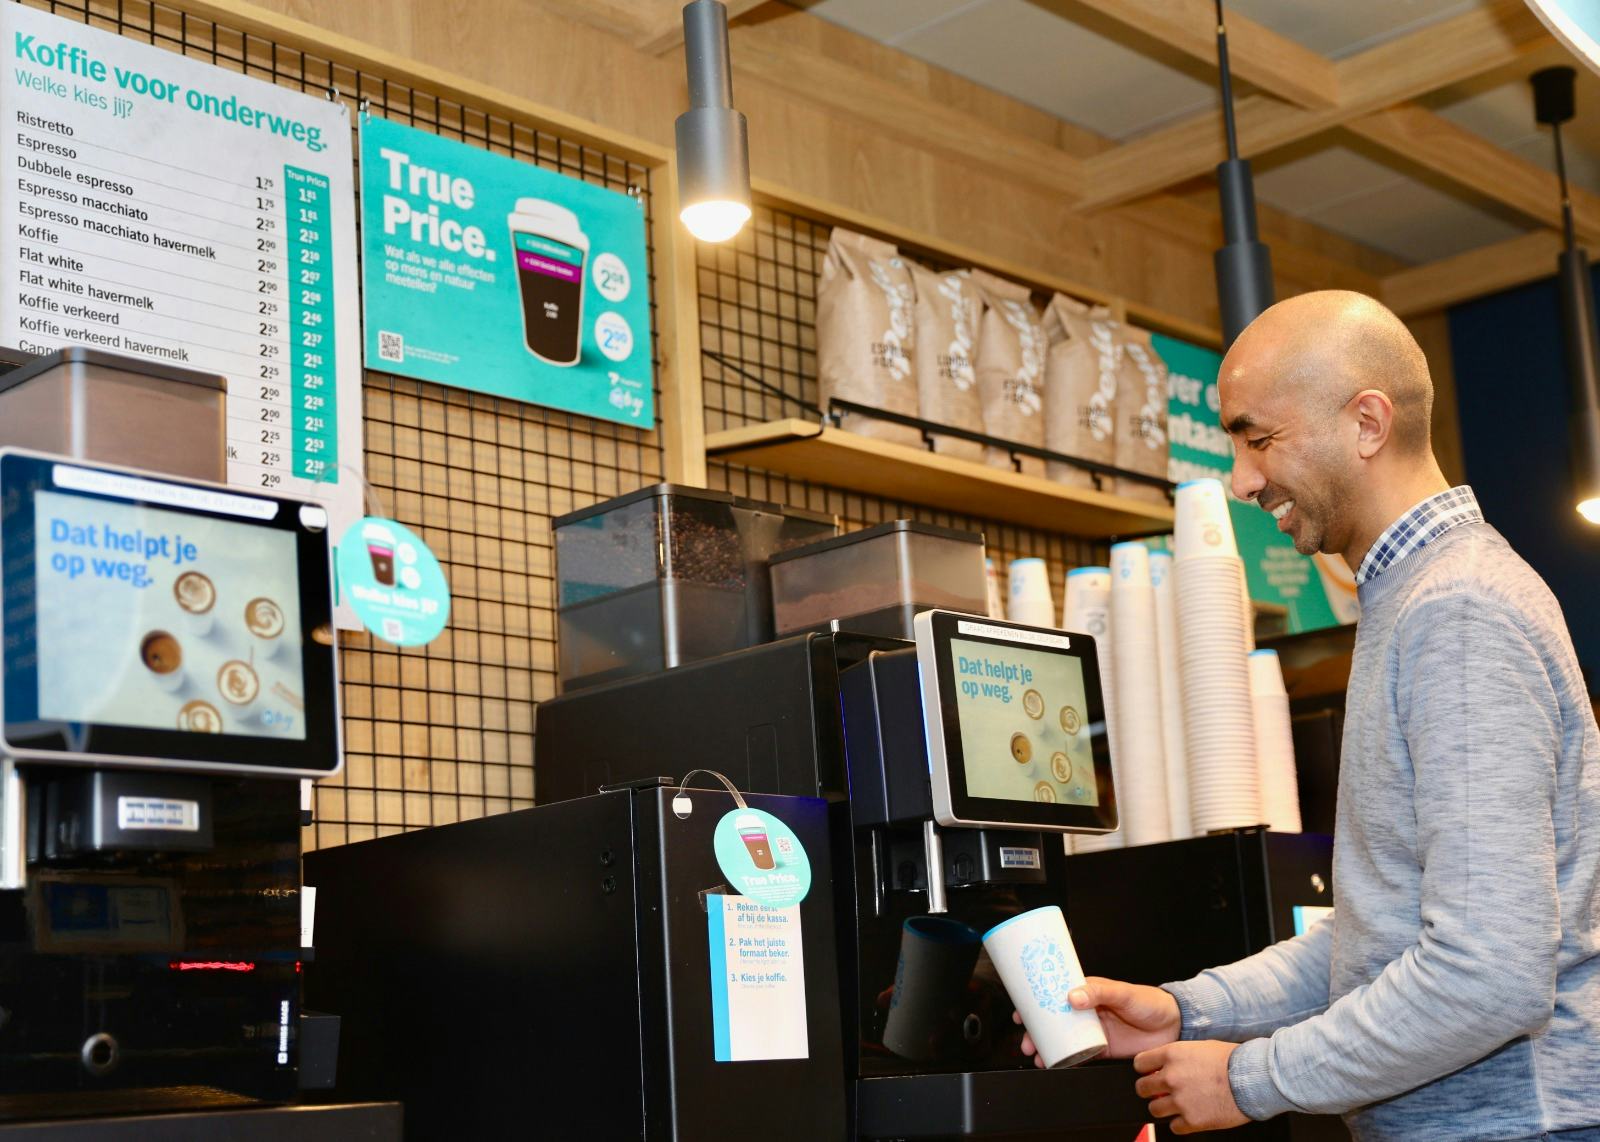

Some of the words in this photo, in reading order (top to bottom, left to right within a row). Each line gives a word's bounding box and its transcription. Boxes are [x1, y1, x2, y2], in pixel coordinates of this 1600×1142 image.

[14, 31, 107, 83] Koffie
[113, 67, 181, 104] voor
[186, 89, 328, 152] onderweg.
[15, 69, 68, 98] Welke
[73, 84, 108, 110] kies
[112, 96, 134, 119] jij?
[17, 111, 74, 137] Ristretto
[17, 133, 77, 160] Espresso
[18, 156, 72, 180] Dubbele
[76, 173, 134, 196] espresso
[286, 169, 305, 182] True
[307, 175, 327, 189] Price
[380, 147, 475, 210] True
[18, 179, 78, 205] Espresso
[82, 195, 148, 221] macchiato
[18, 201, 79, 228] Espresso
[83, 217, 150, 244] macchiato
[153, 234, 216, 260] havermelk
[18, 224, 59, 244] Koffie
[384, 195, 496, 262] Price.
[19, 247, 44, 263] Flat
[48, 253, 84, 272] white
[384, 244, 404, 260] Wat
[406, 251, 420, 264] als
[422, 256, 437, 268] we
[457, 264, 496, 283] effecten
[385, 260, 399, 272] op
[400, 264, 428, 278] mens
[429, 271, 442, 282] en
[444, 275, 475, 291] natuur
[19, 270, 44, 286] Flat
[48, 277, 84, 295] white
[88, 284, 154, 310] havermelk
[19, 293, 59, 312] Koffie
[63, 302, 120, 326] verkeerd
[19, 316, 60, 336] Koffie
[64, 325, 120, 348] verkeerd
[124, 337, 189, 361] havermelk
[50, 518, 97, 547] Dat
[103, 527, 170, 562] helpt
[174, 537, 198, 564] je
[51, 550, 86, 579] op
[92, 557, 154, 588] weg.
[959, 656, 984, 676] Dat
[985, 660, 1019, 682] helpt
[1019, 663, 1033, 686] je
[961, 679, 979, 699] op
[981, 682, 1013, 704] weg.
[727, 903, 734, 911] 1.
[736, 903, 759, 912] Reken
[737, 913, 745, 922] af
[746, 914, 755, 924] bij
[757, 914, 765, 922] de
[767, 914, 789, 923] kassa.
[729, 938, 736, 946] 2.
[739, 938, 752, 946] Pak
[754, 938, 765, 947] het
[767, 938, 785, 949] juiste
[740, 948, 767, 957] formaat
[769, 949, 790, 958] beker.
[731, 973, 738, 982] 3.
[741, 973, 756, 982] Kies
[758, 973, 764, 984] je
[766, 973, 787, 982] koffie.
